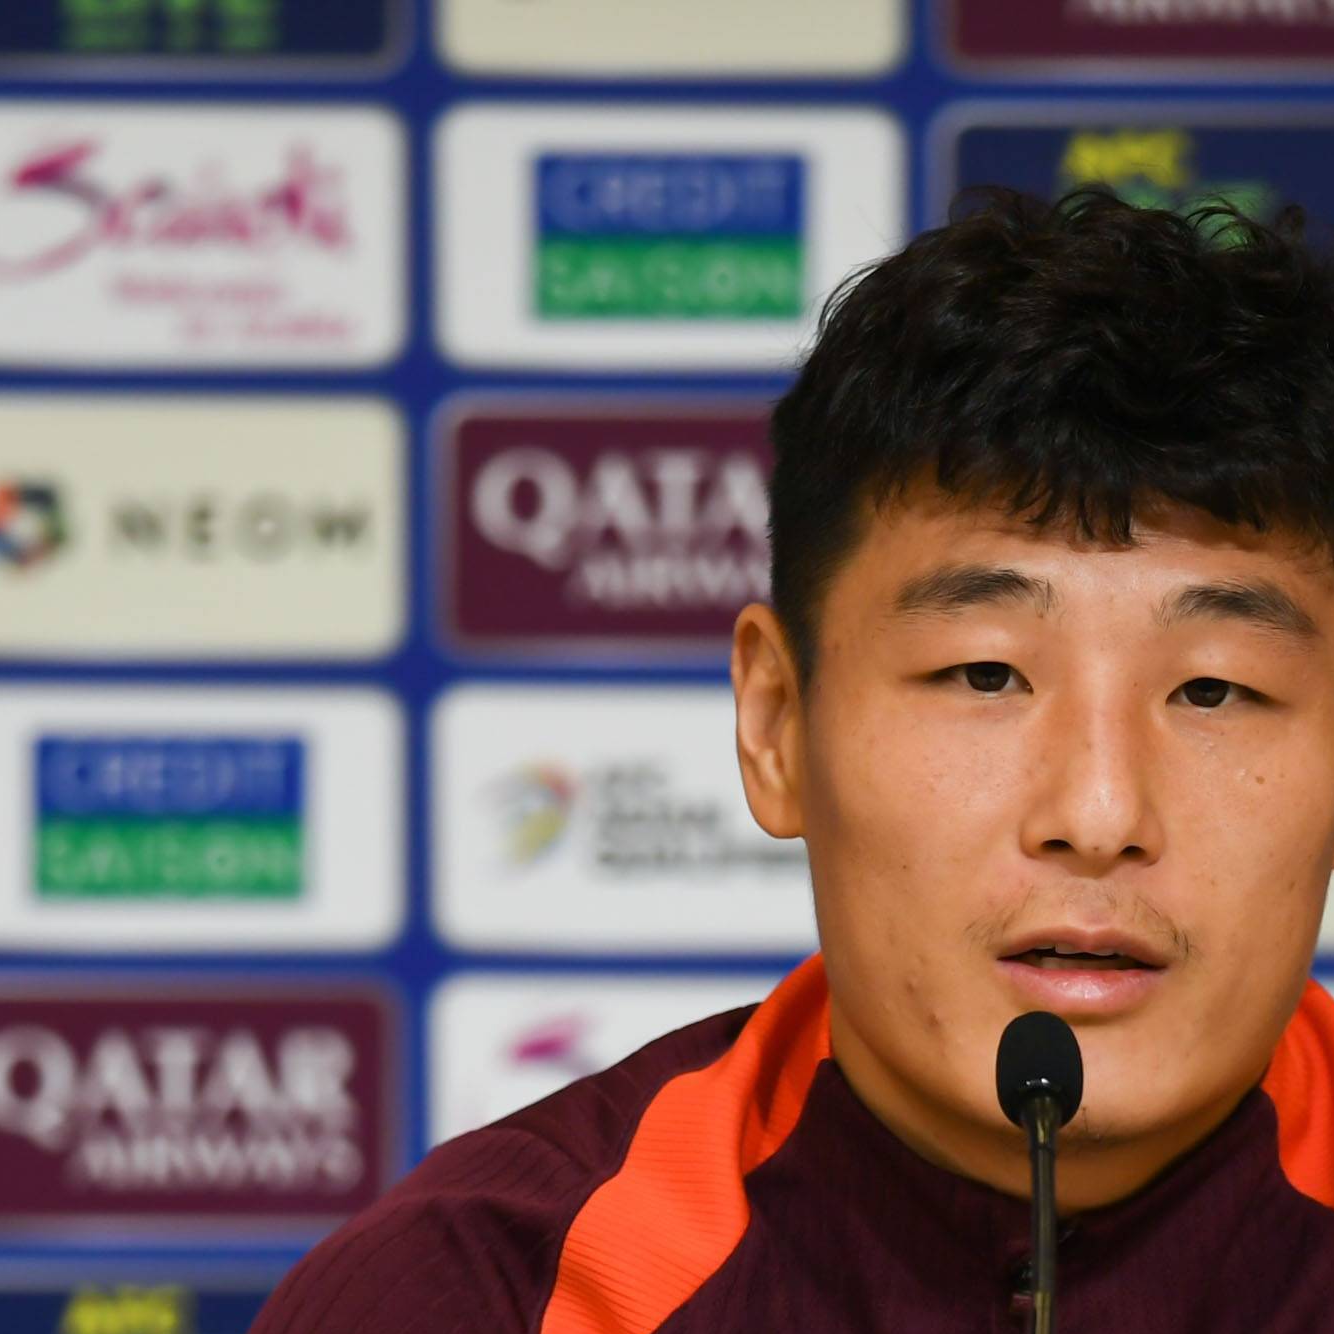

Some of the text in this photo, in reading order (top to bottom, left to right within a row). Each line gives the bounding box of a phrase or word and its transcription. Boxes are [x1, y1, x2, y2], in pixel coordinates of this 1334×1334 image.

[552, 160, 789, 232] CREDIT
[545, 246, 804, 310] SAISON
[112, 500, 372, 565] NEOM
[472, 448, 772, 570] QATA
[52, 745, 287, 810] CREDIT
[43, 825, 299, 888] SAISON
[79, 1132, 362, 1188] AIRWAYS
